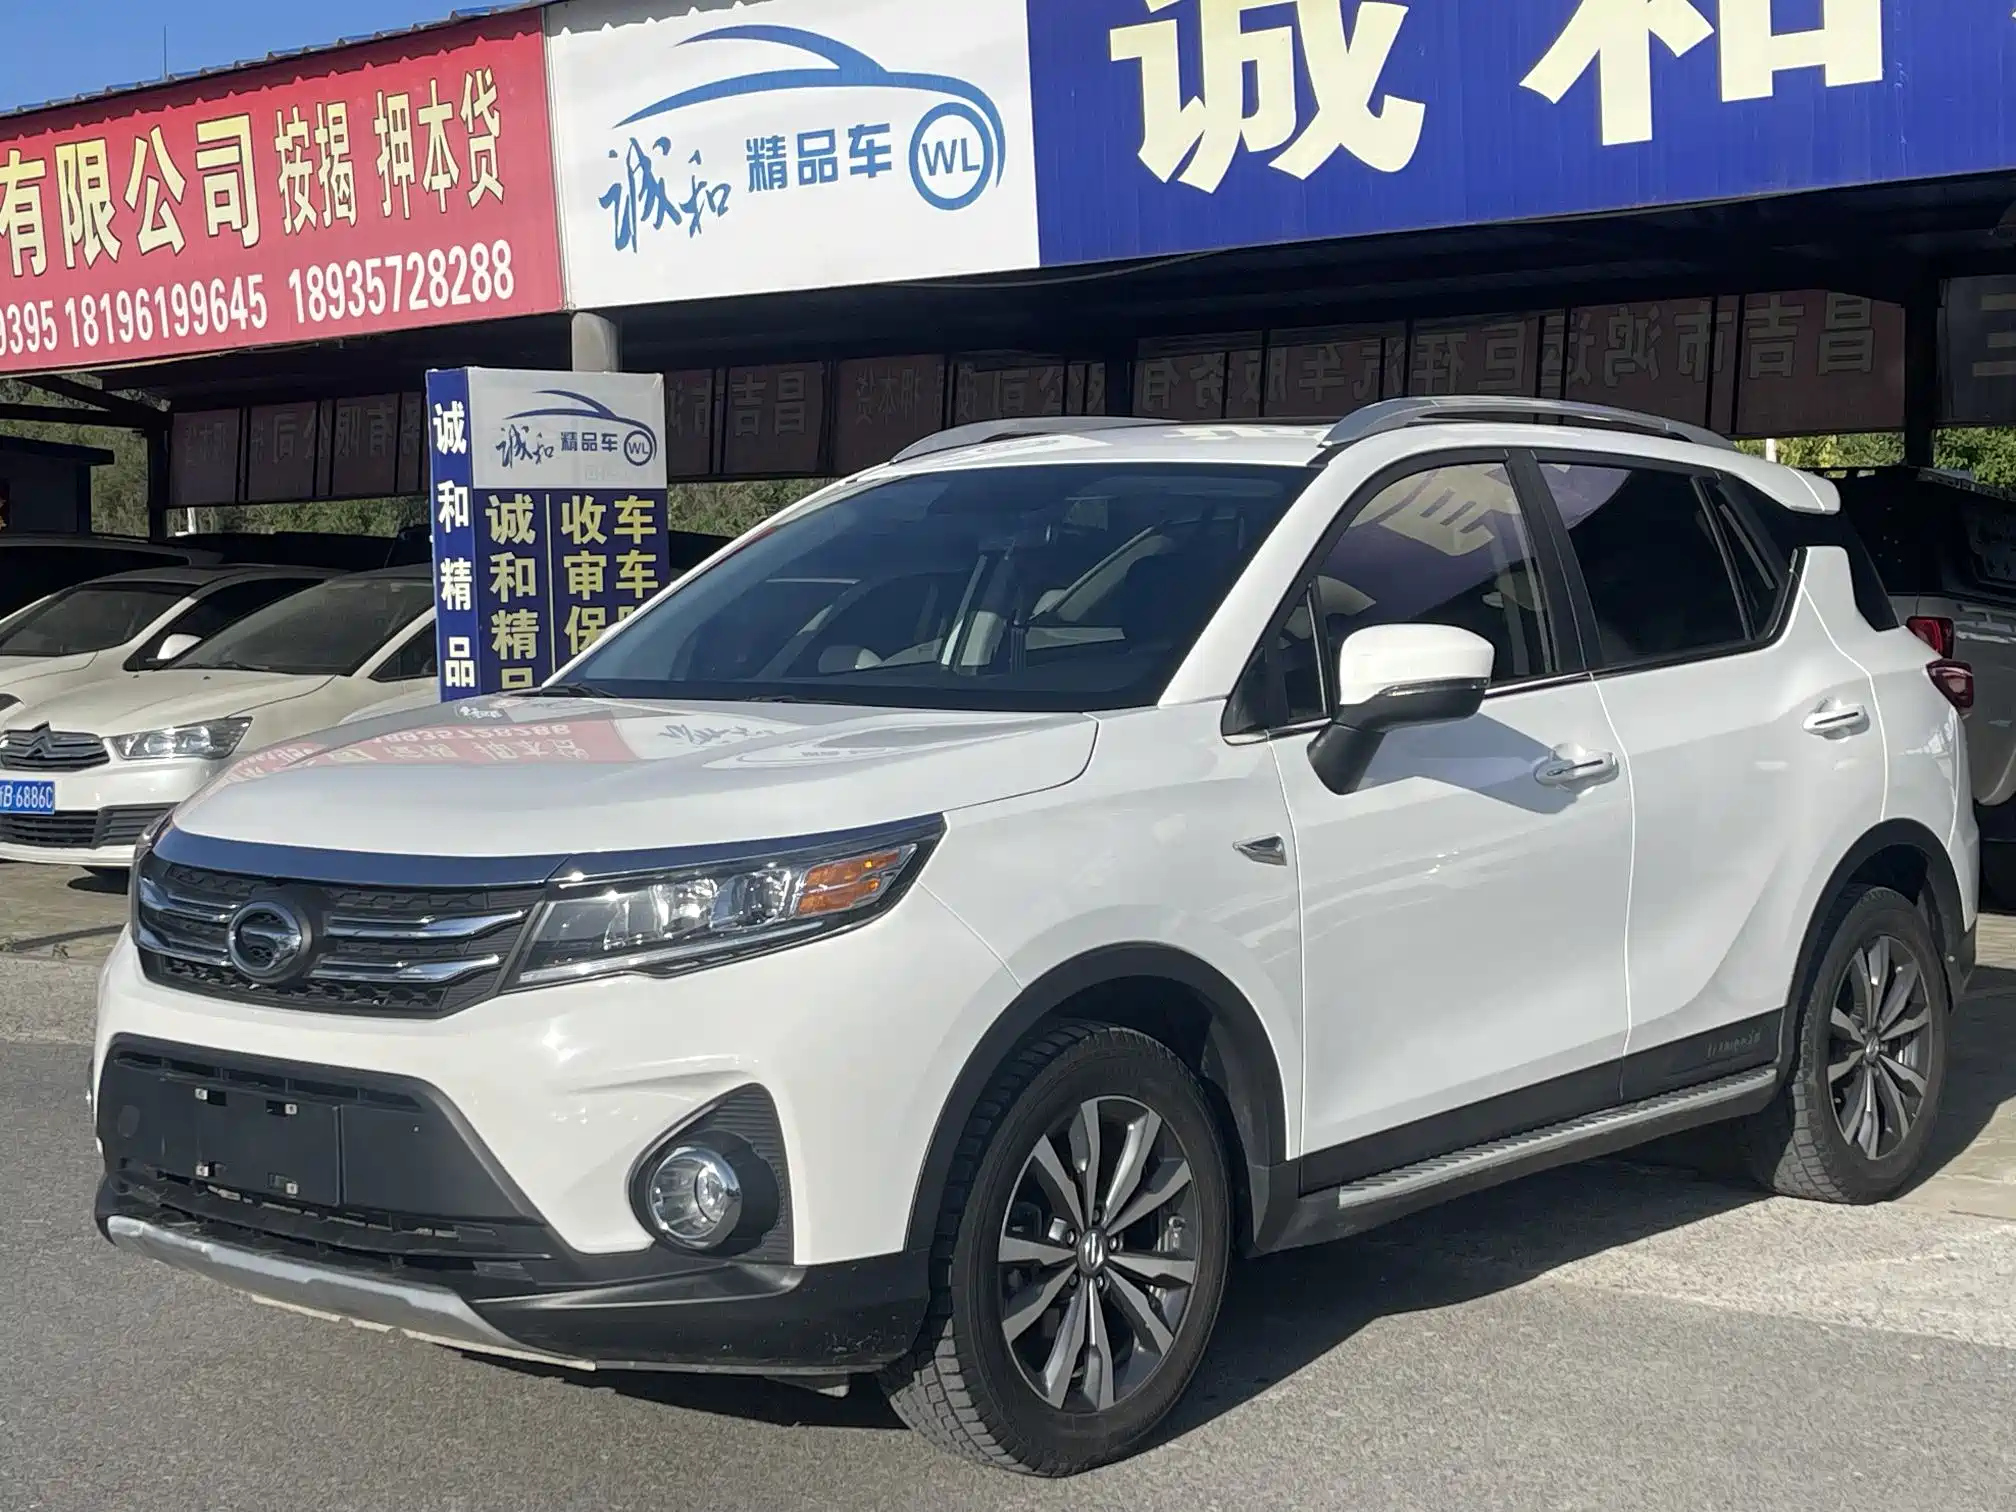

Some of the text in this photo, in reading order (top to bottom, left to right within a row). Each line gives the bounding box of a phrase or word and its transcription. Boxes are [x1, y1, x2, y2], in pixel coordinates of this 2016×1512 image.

[0, 66, 505, 277] 有限公司 按揭 押本贷
[745, 123, 892, 192] 精品车
[921, 137, 981, 176] WL
[64, 274, 268, 348] 18196199645
[289, 240, 514, 323] 18935728288
[561, 431, 618, 452] 精品车
[628, 442, 649, 454] WL
[433, 401, 475, 687] 诚和精品
[561, 495, 657, 544] 收车
[563, 550, 659, 601] 审车
[563, 605, 634, 656] 保
